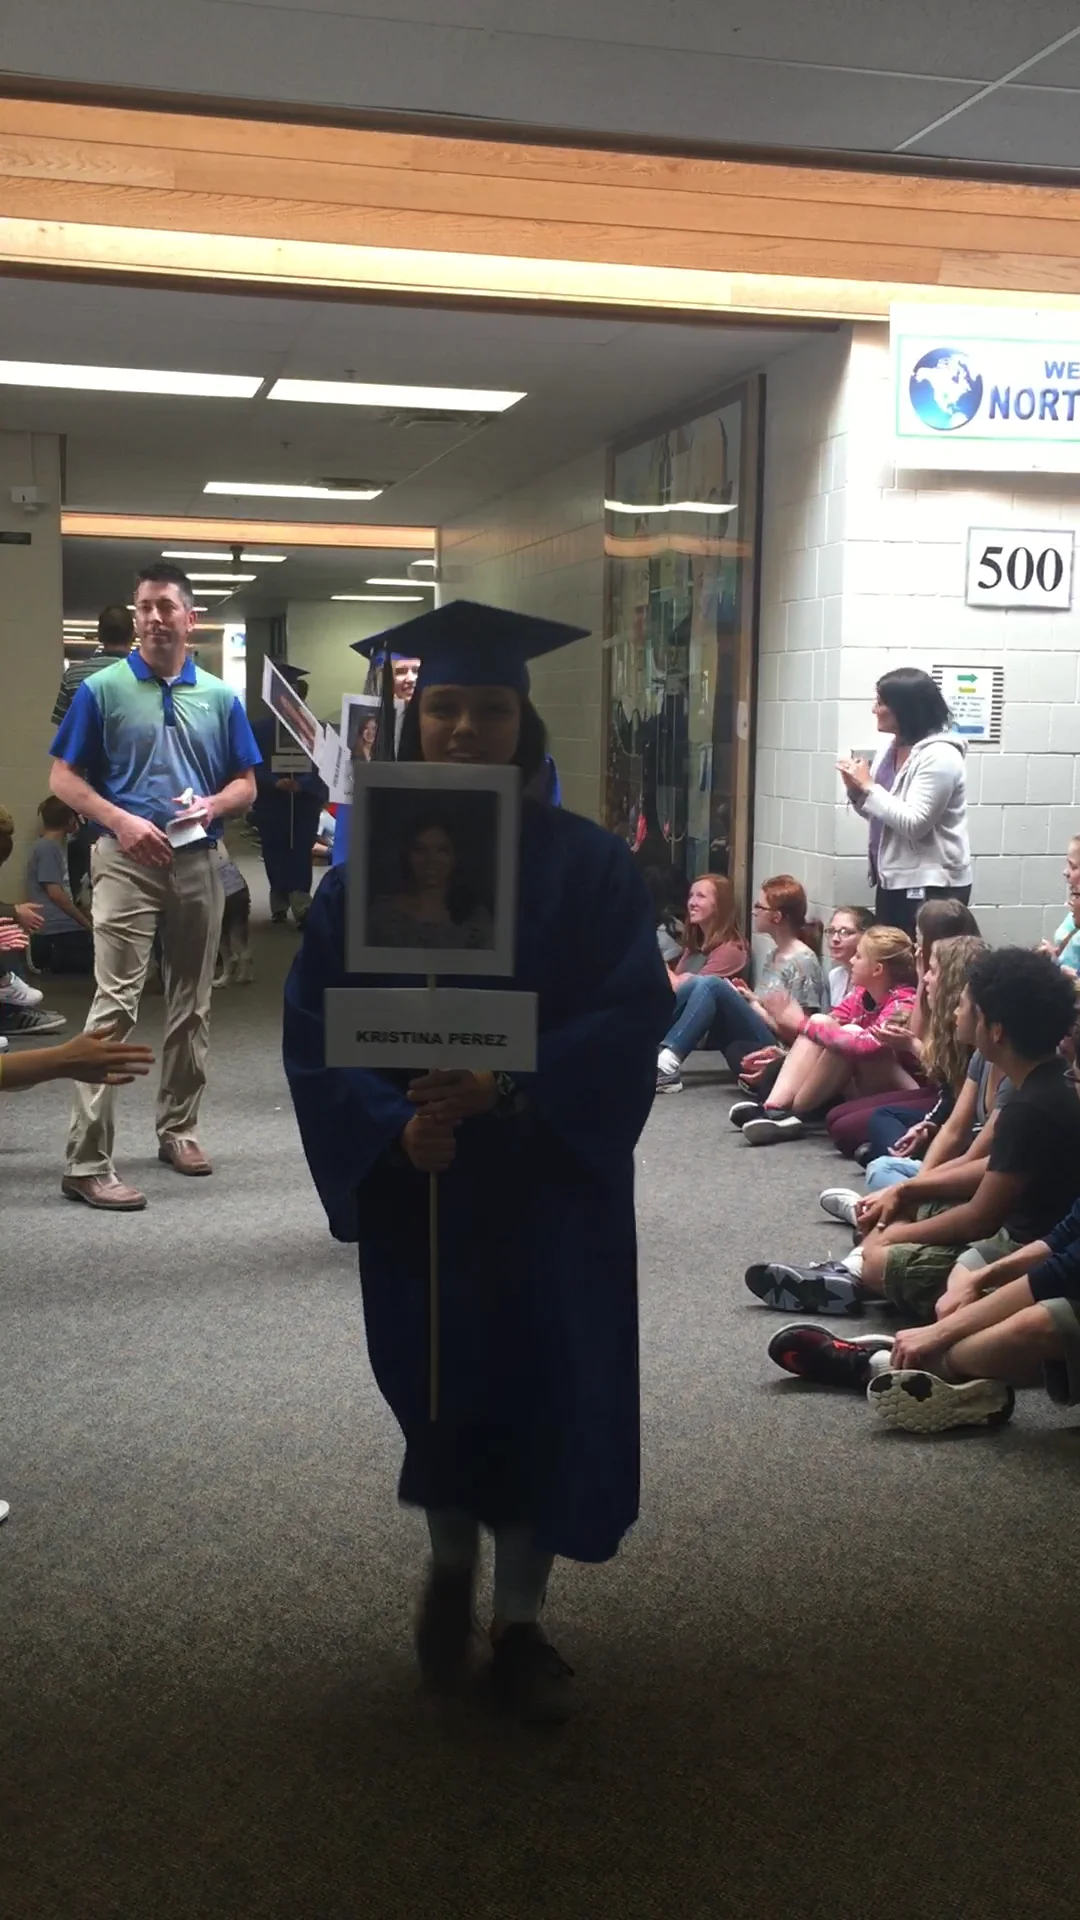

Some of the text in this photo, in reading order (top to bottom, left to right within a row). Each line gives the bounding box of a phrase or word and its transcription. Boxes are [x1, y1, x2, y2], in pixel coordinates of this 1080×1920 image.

[1044, 360, 1080, 379] WE
[989, 385, 1080, 421] NORT
[978, 546, 1063, 592] 500
[355, 1030, 508, 1047] KRISTINA PEREZ
